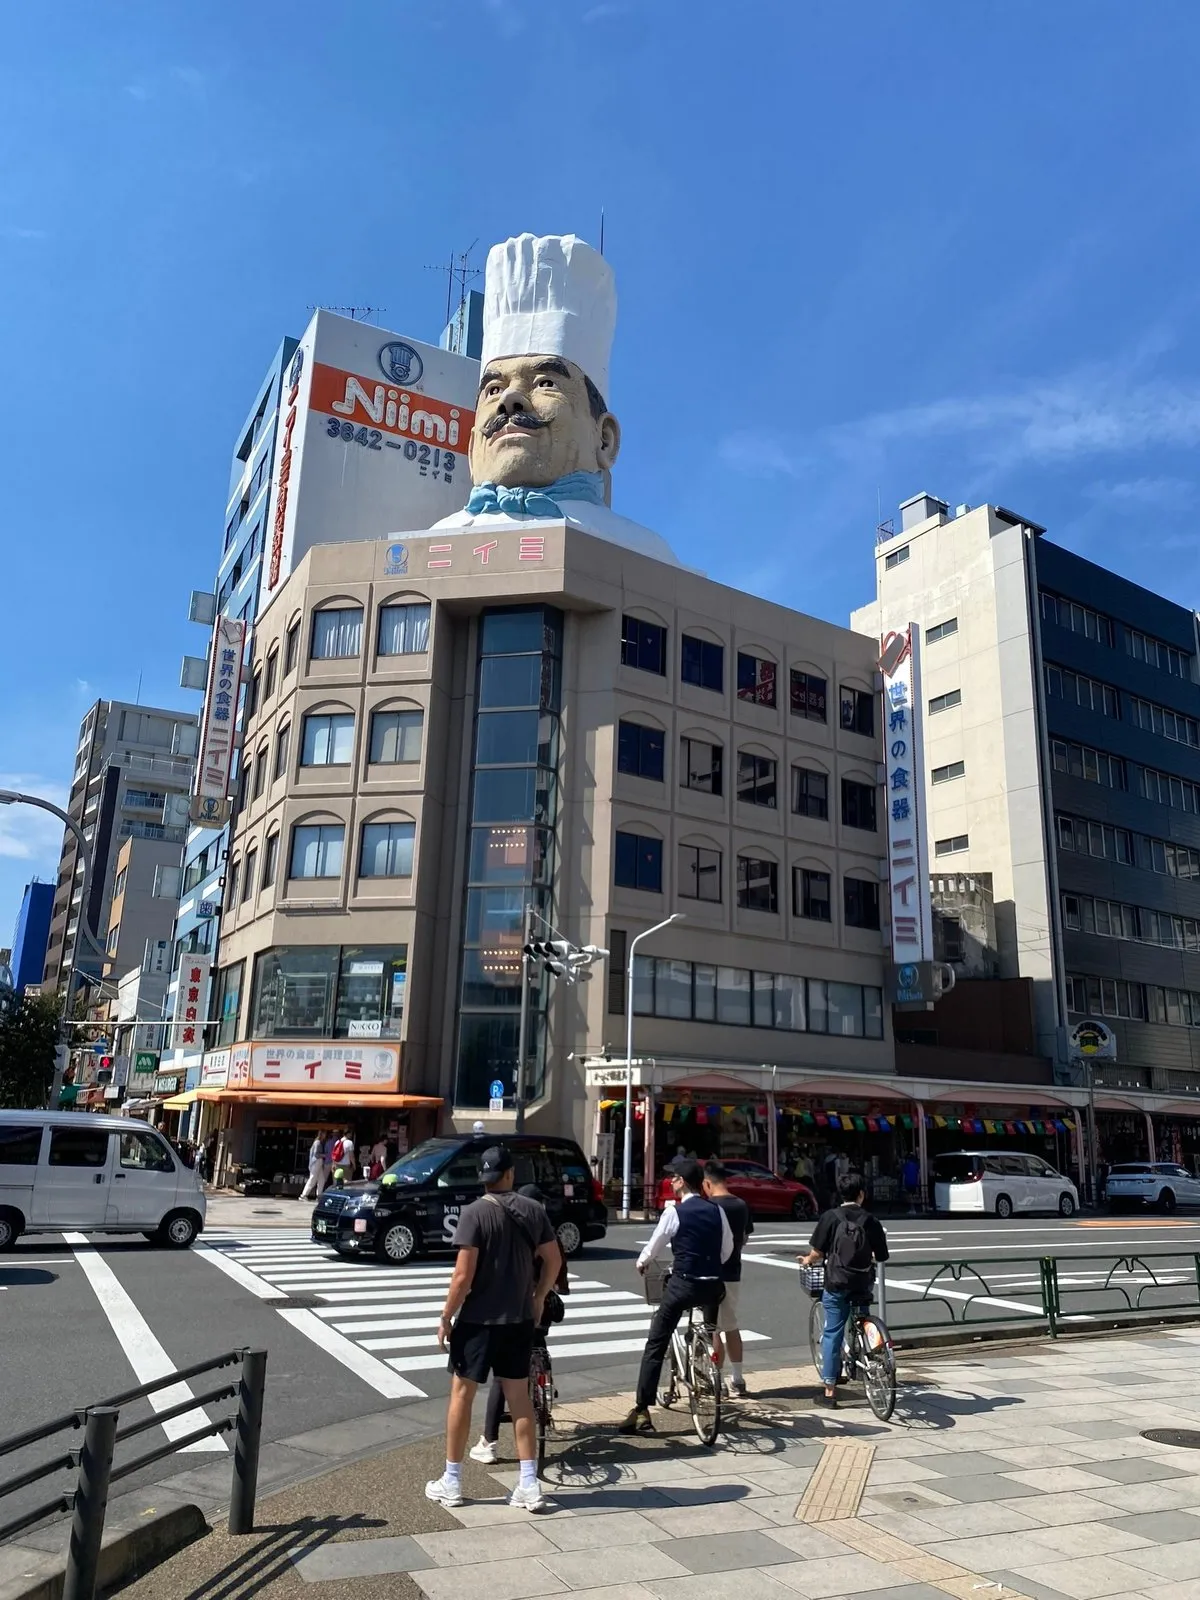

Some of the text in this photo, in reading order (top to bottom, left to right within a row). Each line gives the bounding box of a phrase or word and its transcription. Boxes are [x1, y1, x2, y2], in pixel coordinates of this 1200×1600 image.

[331, 376, 460, 446] Niimi
[326, 417, 456, 472] 3842-0213
[419, 465, 453, 484] ニイミ
[427, 536, 545, 569] ニイミ
[204, 648, 237, 787] 世界の食器 ニイミ
[888, 680, 918, 944] 世界の食器 ニイミ
[350, 1022, 380, 1031] NIKKO
[264, 1060, 362, 1080] ニイミ
